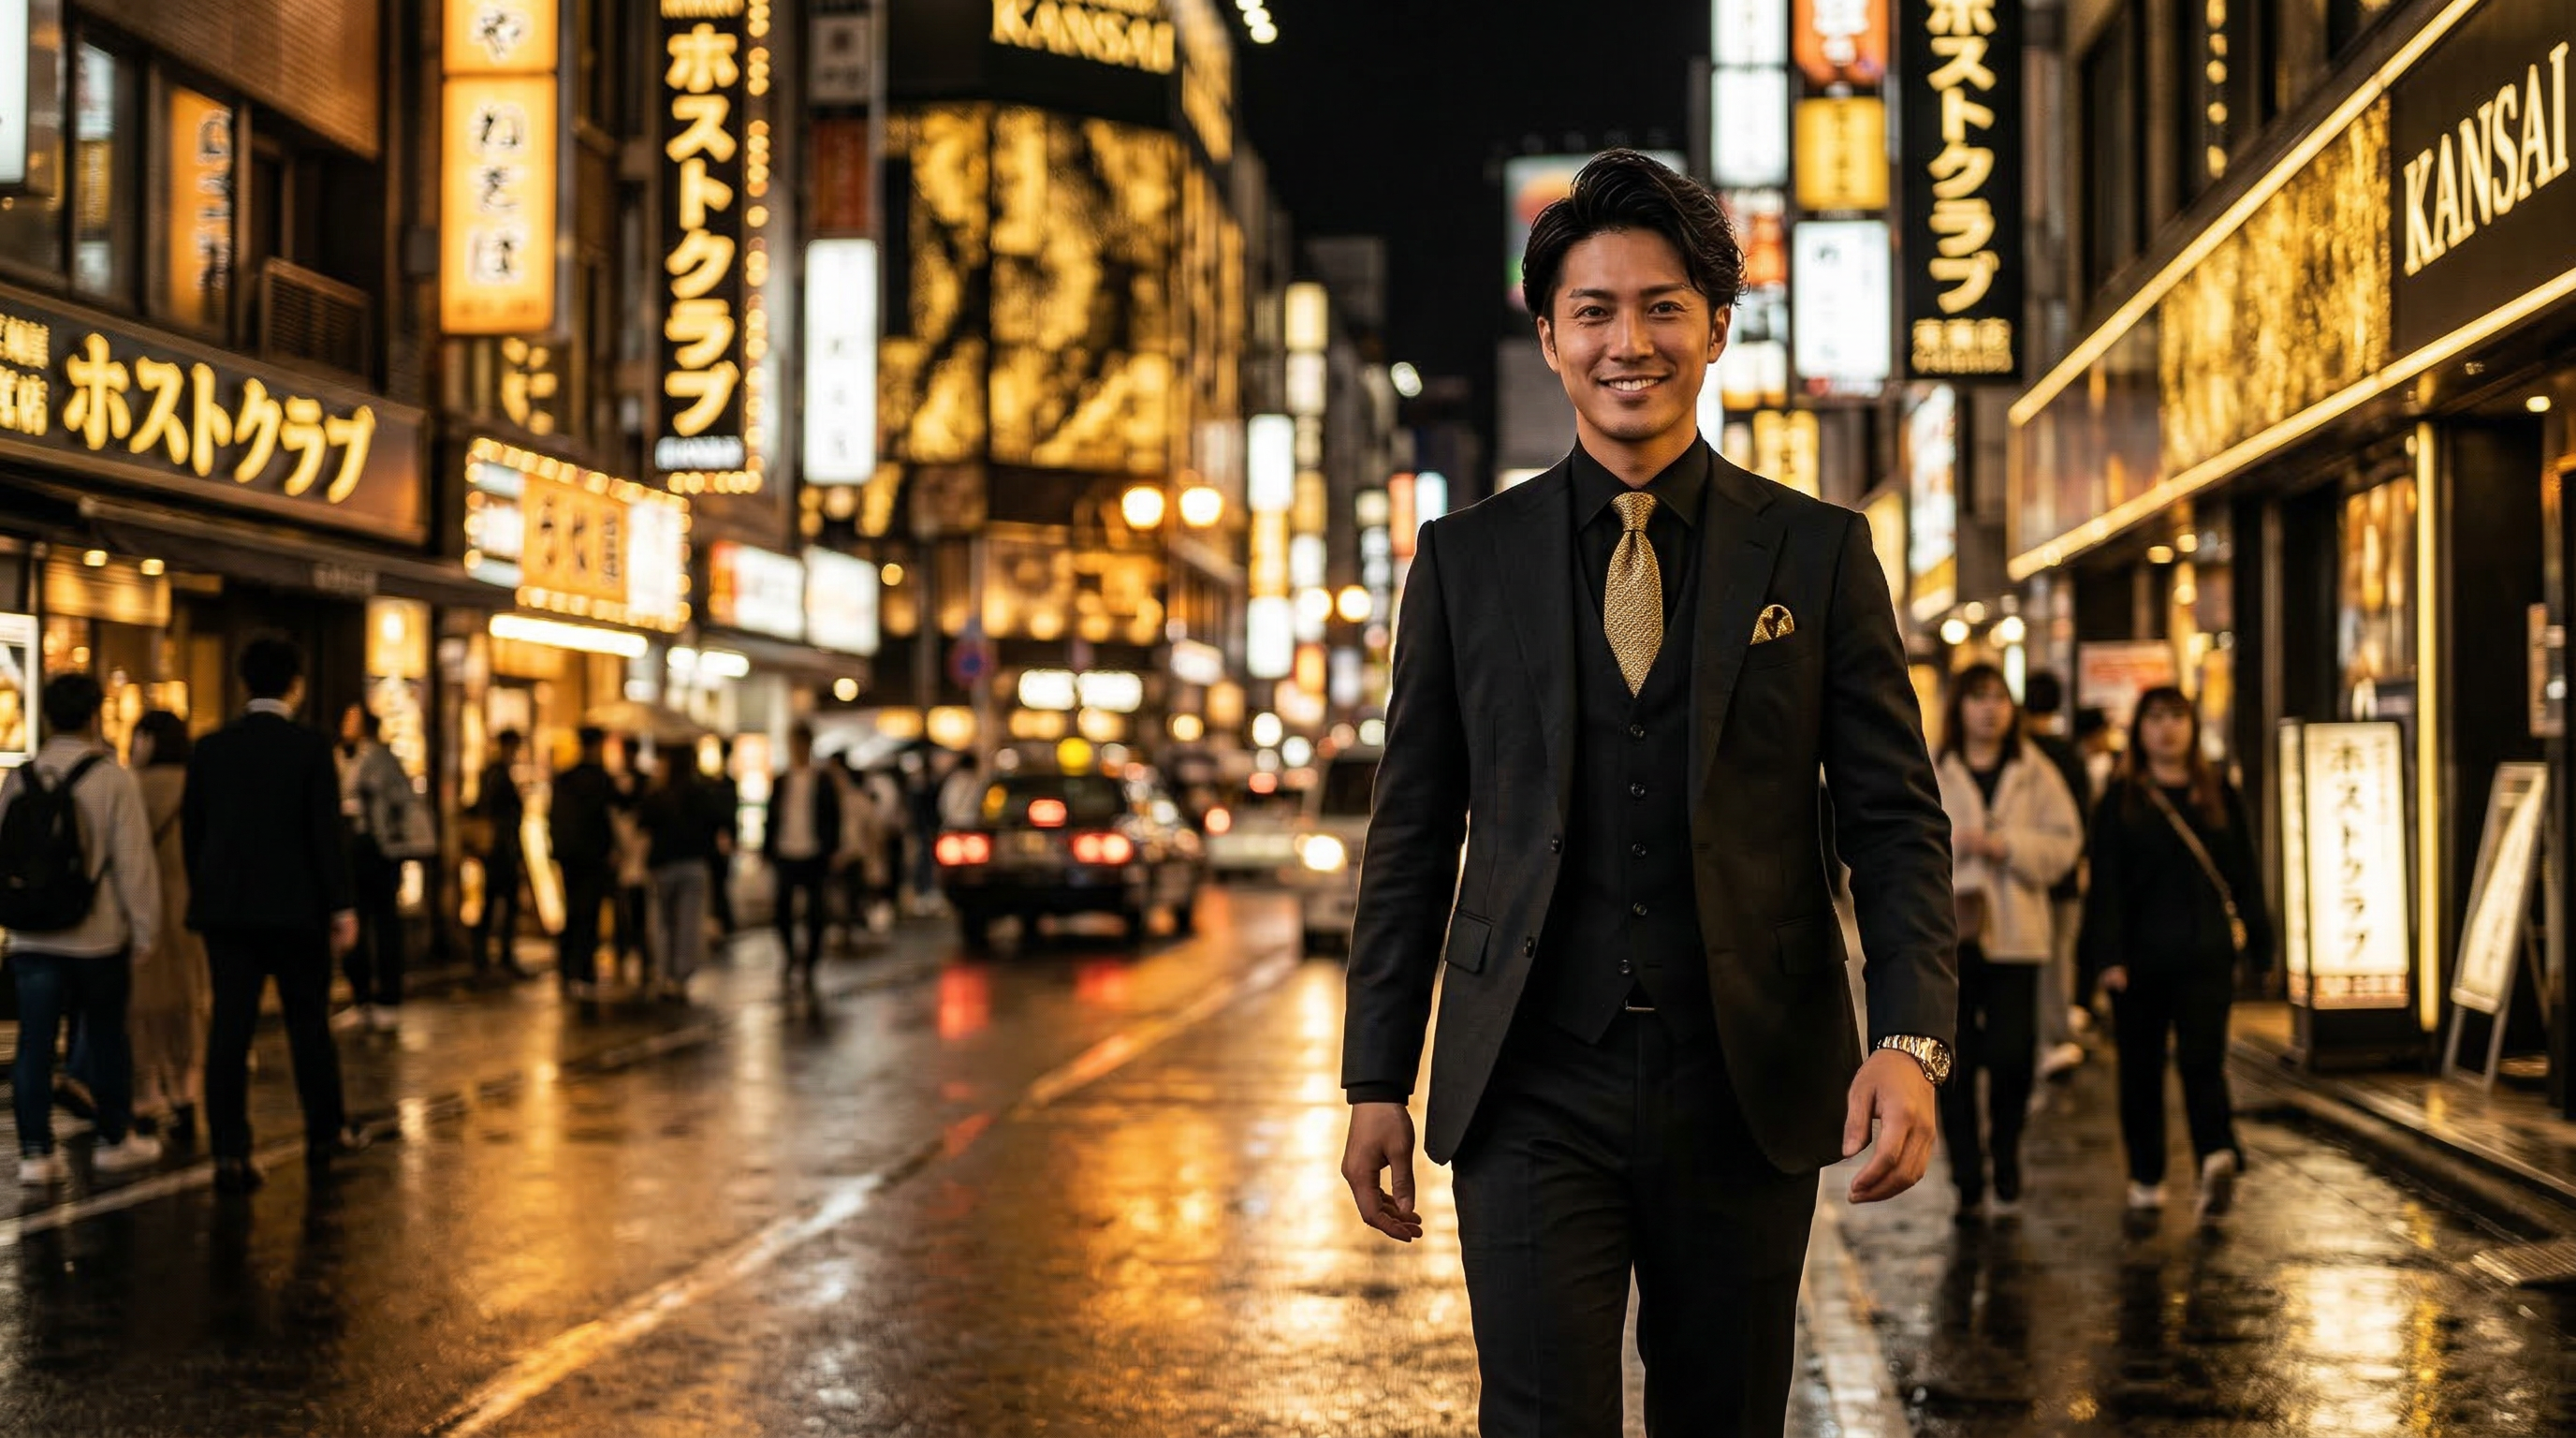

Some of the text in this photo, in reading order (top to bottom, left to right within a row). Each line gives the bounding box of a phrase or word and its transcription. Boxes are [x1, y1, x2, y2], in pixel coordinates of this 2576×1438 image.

[1925, 0, 2000, 315] ホストクラブ
[2403, 41, 2570, 277] KANSAI
